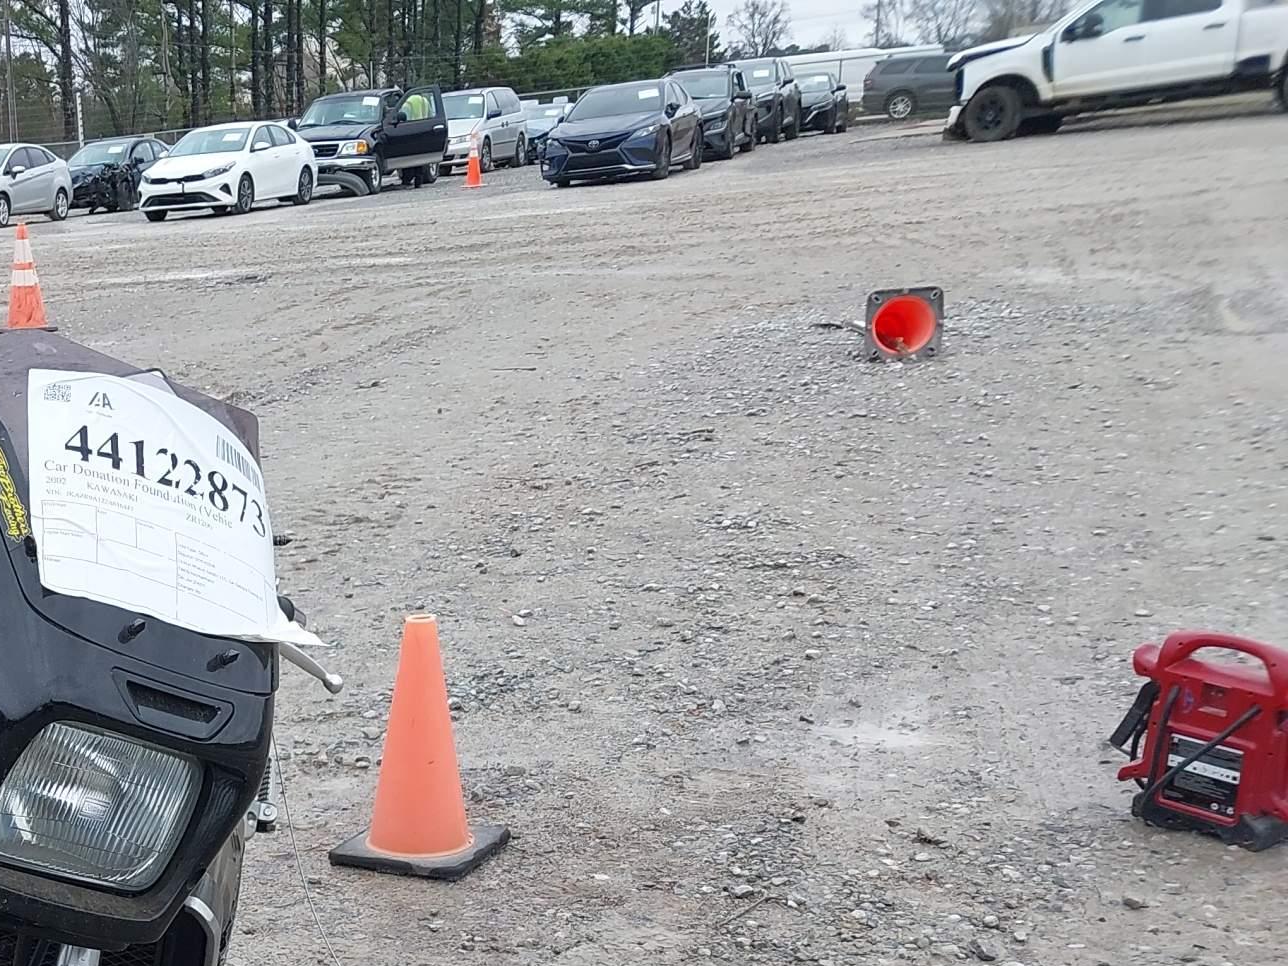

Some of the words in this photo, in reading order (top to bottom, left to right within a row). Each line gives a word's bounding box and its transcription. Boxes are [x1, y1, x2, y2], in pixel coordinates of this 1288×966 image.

[44, 459, 68, 474] Car
[72, 463, 131, 489] Donation
[134, 478, 197, 511] Foundation
[64, 424, 266, 538] 44122873
[86, 481, 139, 503] KAWASAKI
